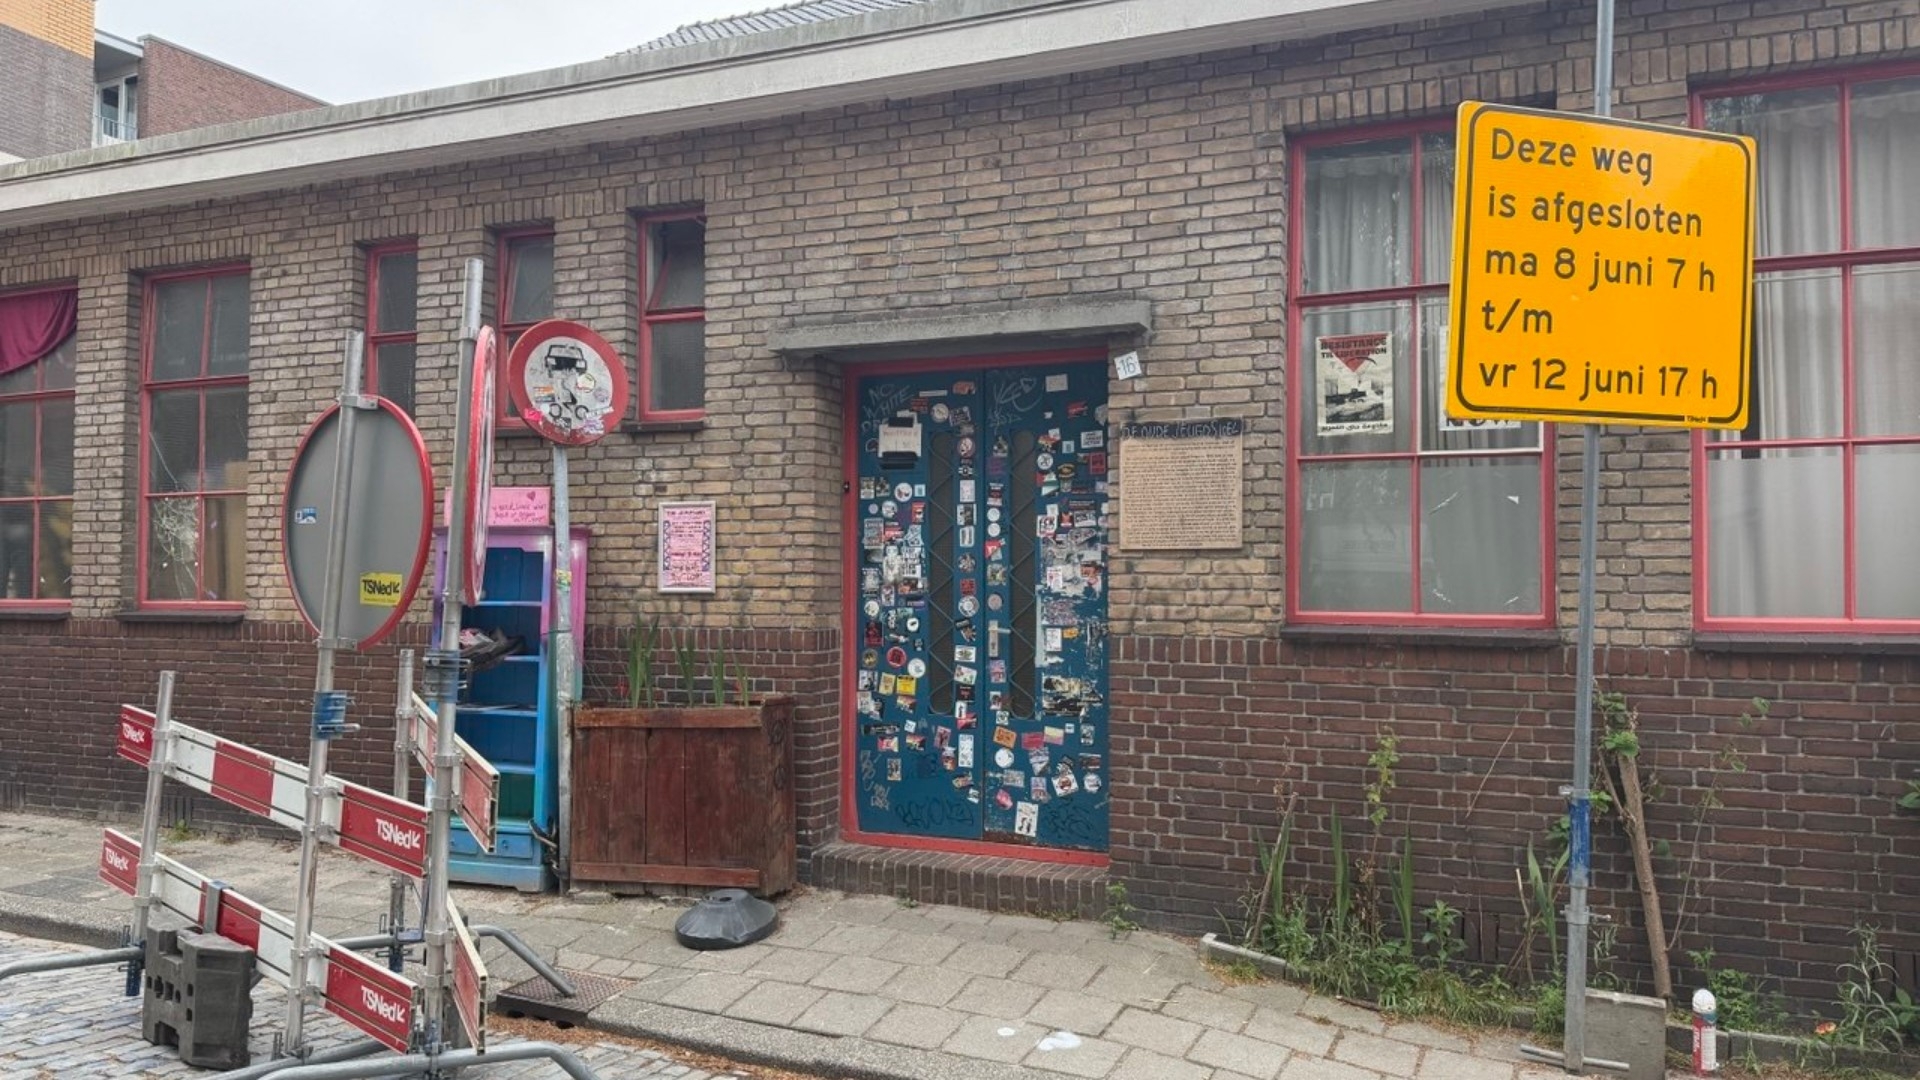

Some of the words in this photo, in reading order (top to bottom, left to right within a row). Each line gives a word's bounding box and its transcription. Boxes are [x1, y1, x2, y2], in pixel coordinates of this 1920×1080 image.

[1491, 127, 1577, 168] Deze
[1592, 146, 1652, 187] weg
[1488, 186, 1516, 219] is
[1532, 191, 1702, 237] afgesloten
[1485, 249, 1538, 277] ma
[1554, 247, 1576, 280] 8
[1588, 252, 1653, 292] juni
[1667, 258, 1686, 289] 7
[1699, 261, 1715, 292] h
[1481, 298, 1553, 334] t/m
[1120, 356, 1136, 376] 16
[1479, 362, 1517, 388] vr
[1532, 358, 1567, 391] 12
[1579, 361, 1644, 402] juni
[1659, 365, 1689, 396] 17
[1701, 369, 1718, 399] h
